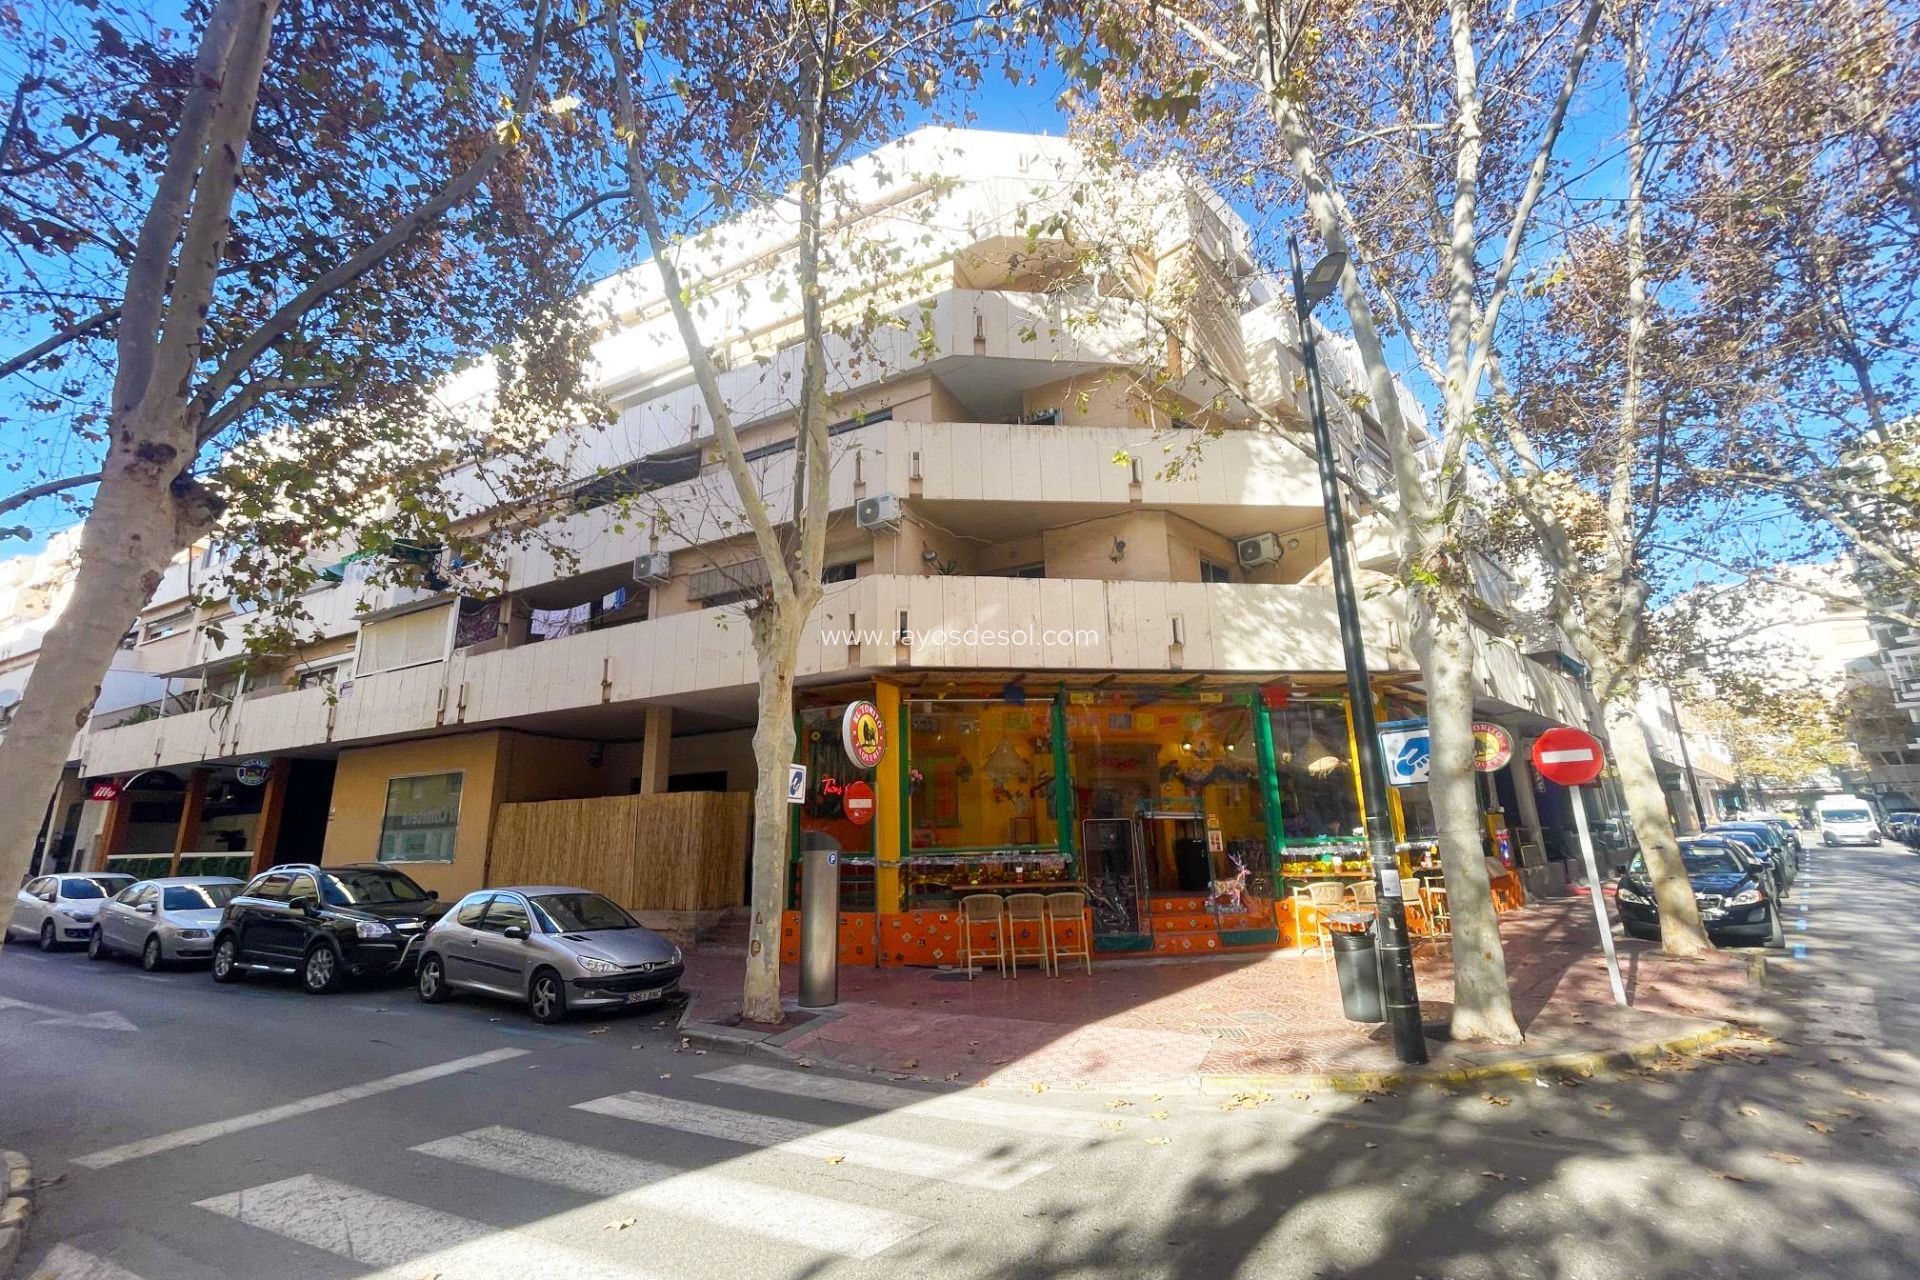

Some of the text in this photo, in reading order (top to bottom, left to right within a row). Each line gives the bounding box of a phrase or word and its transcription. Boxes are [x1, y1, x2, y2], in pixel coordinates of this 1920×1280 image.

[859, 703, 882, 728] TORITO
[1472, 723, 1503, 738] ORITO
[95, 786, 116, 799] illy
